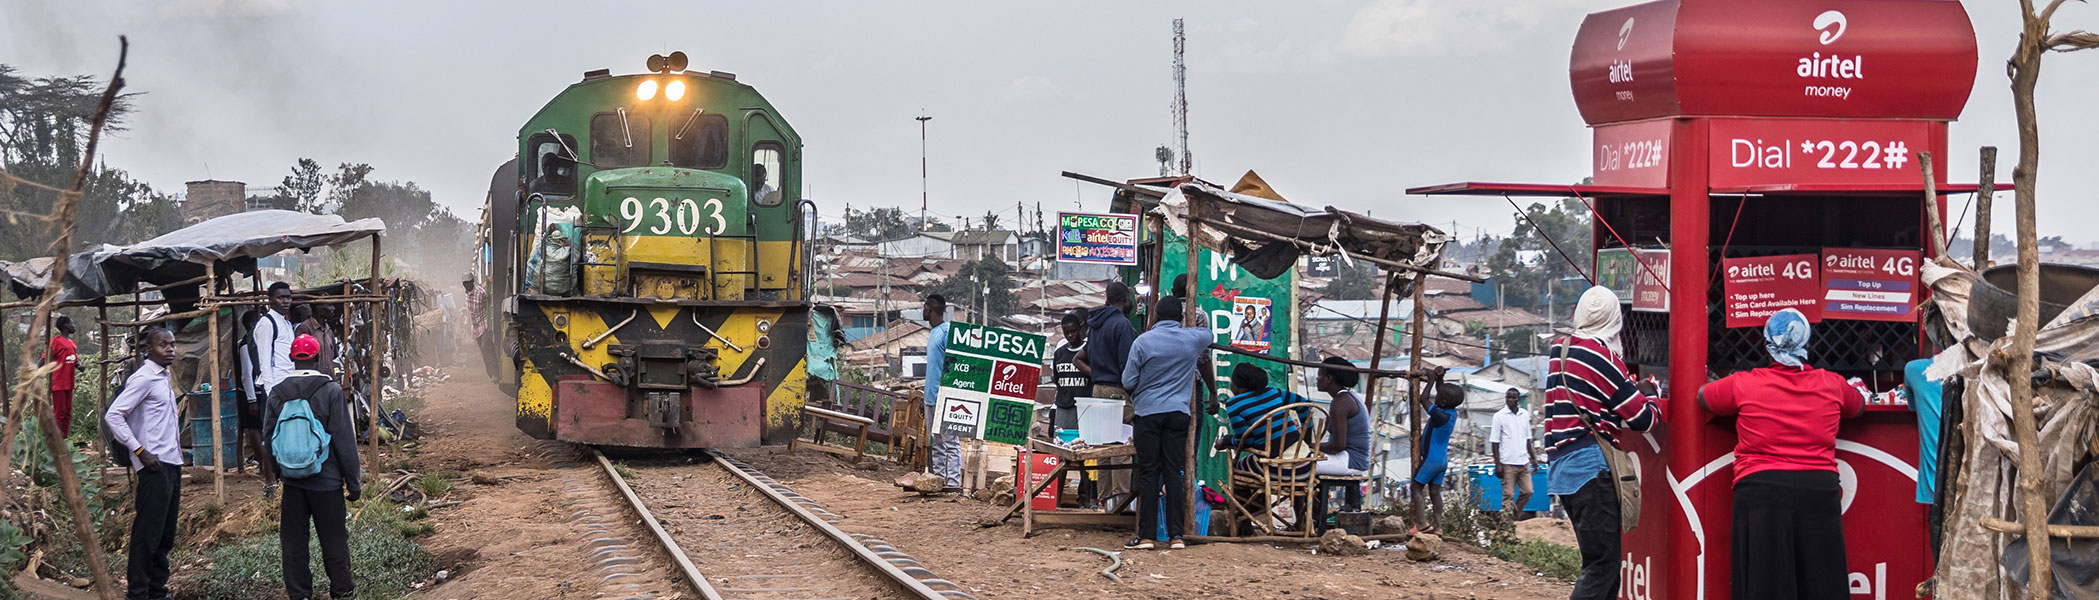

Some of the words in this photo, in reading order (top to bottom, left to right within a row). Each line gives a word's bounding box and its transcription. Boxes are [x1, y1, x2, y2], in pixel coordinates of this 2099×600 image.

[1609, 59, 1633, 83] airtel
[1797, 52, 1863, 79] airtel
[1615, 90, 1634, 102] money
[1804, 86, 1851, 100] money
[1600, 142, 1622, 171] Dial
[1731, 139, 1790, 168] Dial
[620, 197, 727, 236] 9303
[1061, 229, 1081, 241] KCB
[1087, 230, 1109, 243] airtel
[1109, 236, 1133, 244] EQUITY
[1643, 257, 1667, 286] airtel
[1741, 263, 1775, 277] airtel
[1782, 260, 1812, 280] 4G
[1839, 253, 1875, 269] airtel
[1882, 256, 1914, 276] 4G
[1858, 280, 1871, 288] Top
[1734, 293, 1748, 301] Top
[1767, 299, 1799, 307] Available
[1750, 309, 1777, 318] Replac
[1854, 303, 1898, 312] Replacement
[954, 363, 970, 373] KCB
[952, 378, 975, 389] Agent
[994, 381, 1024, 395] airtel
[948, 412, 974, 421] EQUITY
[947, 424, 973, 433] AGENT
[1043, 457, 1057, 465] 4G
[1617, 551, 1652, 600] rtel
